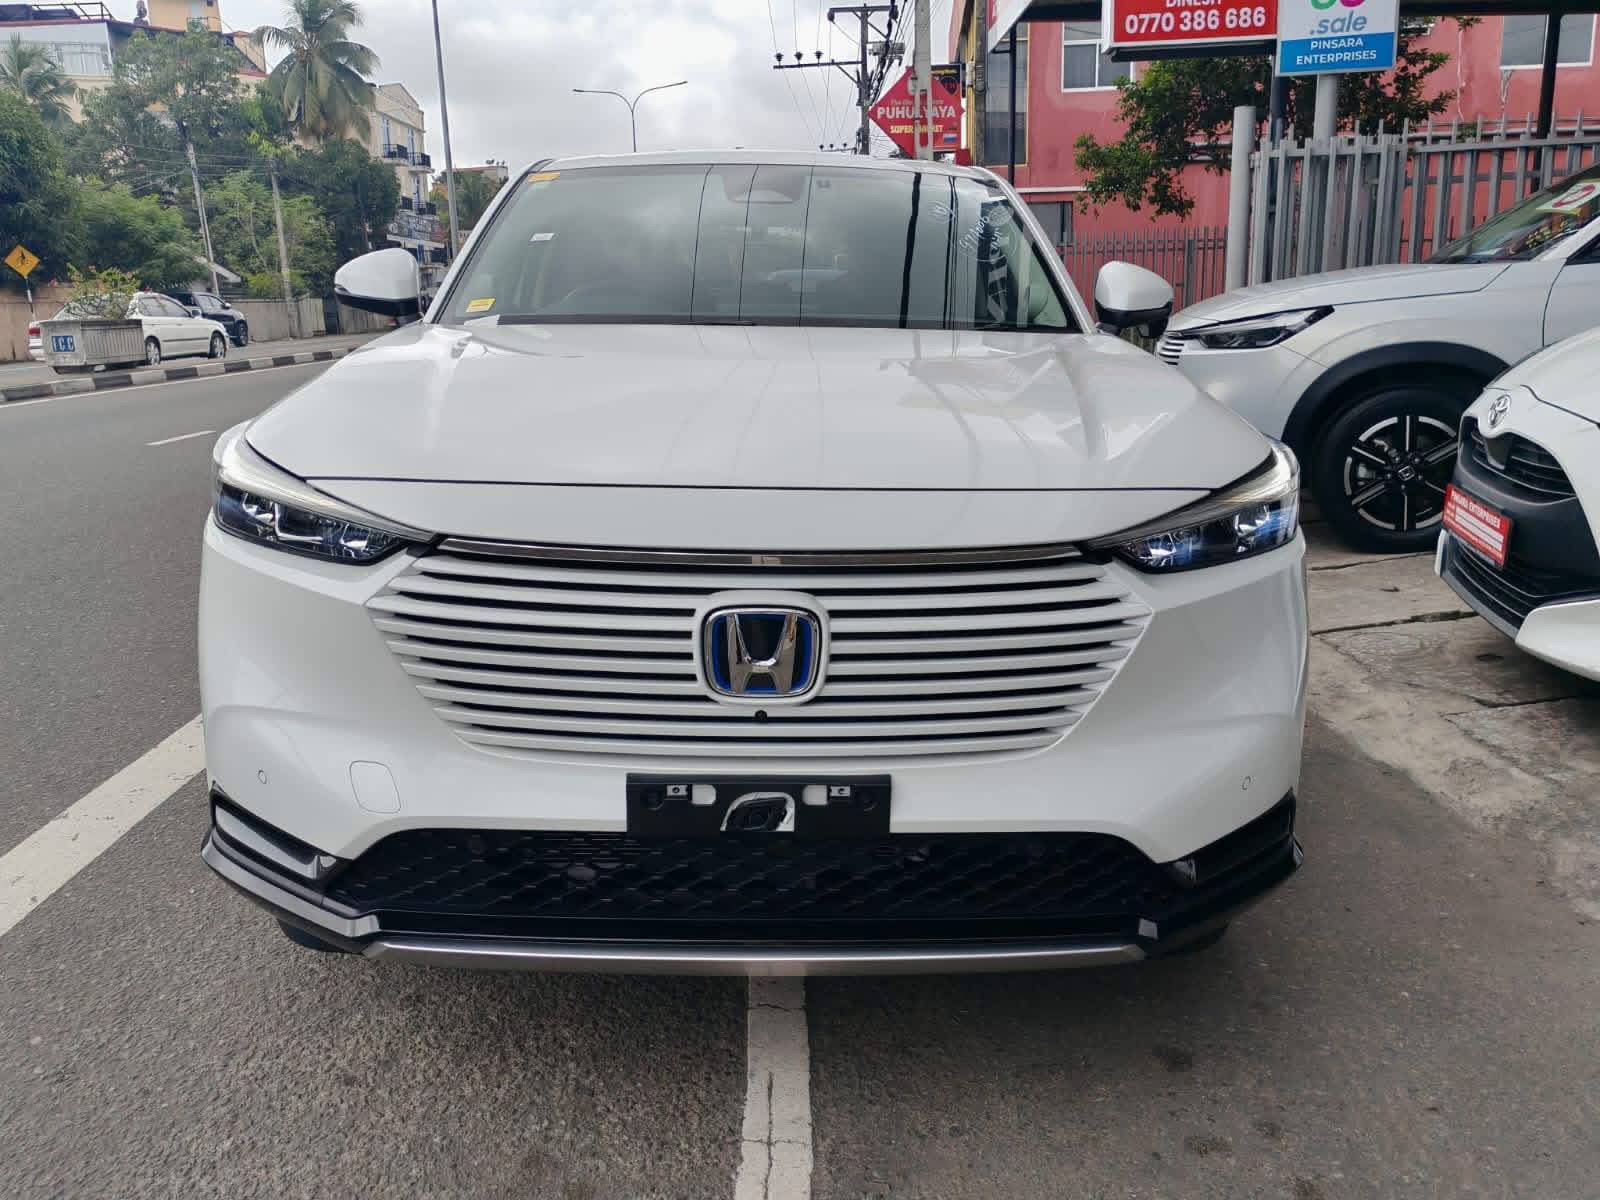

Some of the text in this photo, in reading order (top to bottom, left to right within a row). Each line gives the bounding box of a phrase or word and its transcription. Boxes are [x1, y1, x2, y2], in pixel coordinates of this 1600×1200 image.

[1125, 6, 1266, 34] 0770 386 686
[1310, 37, 1364, 50] PINSARA
[1296, 50, 1377, 65] ENTERPRISES
